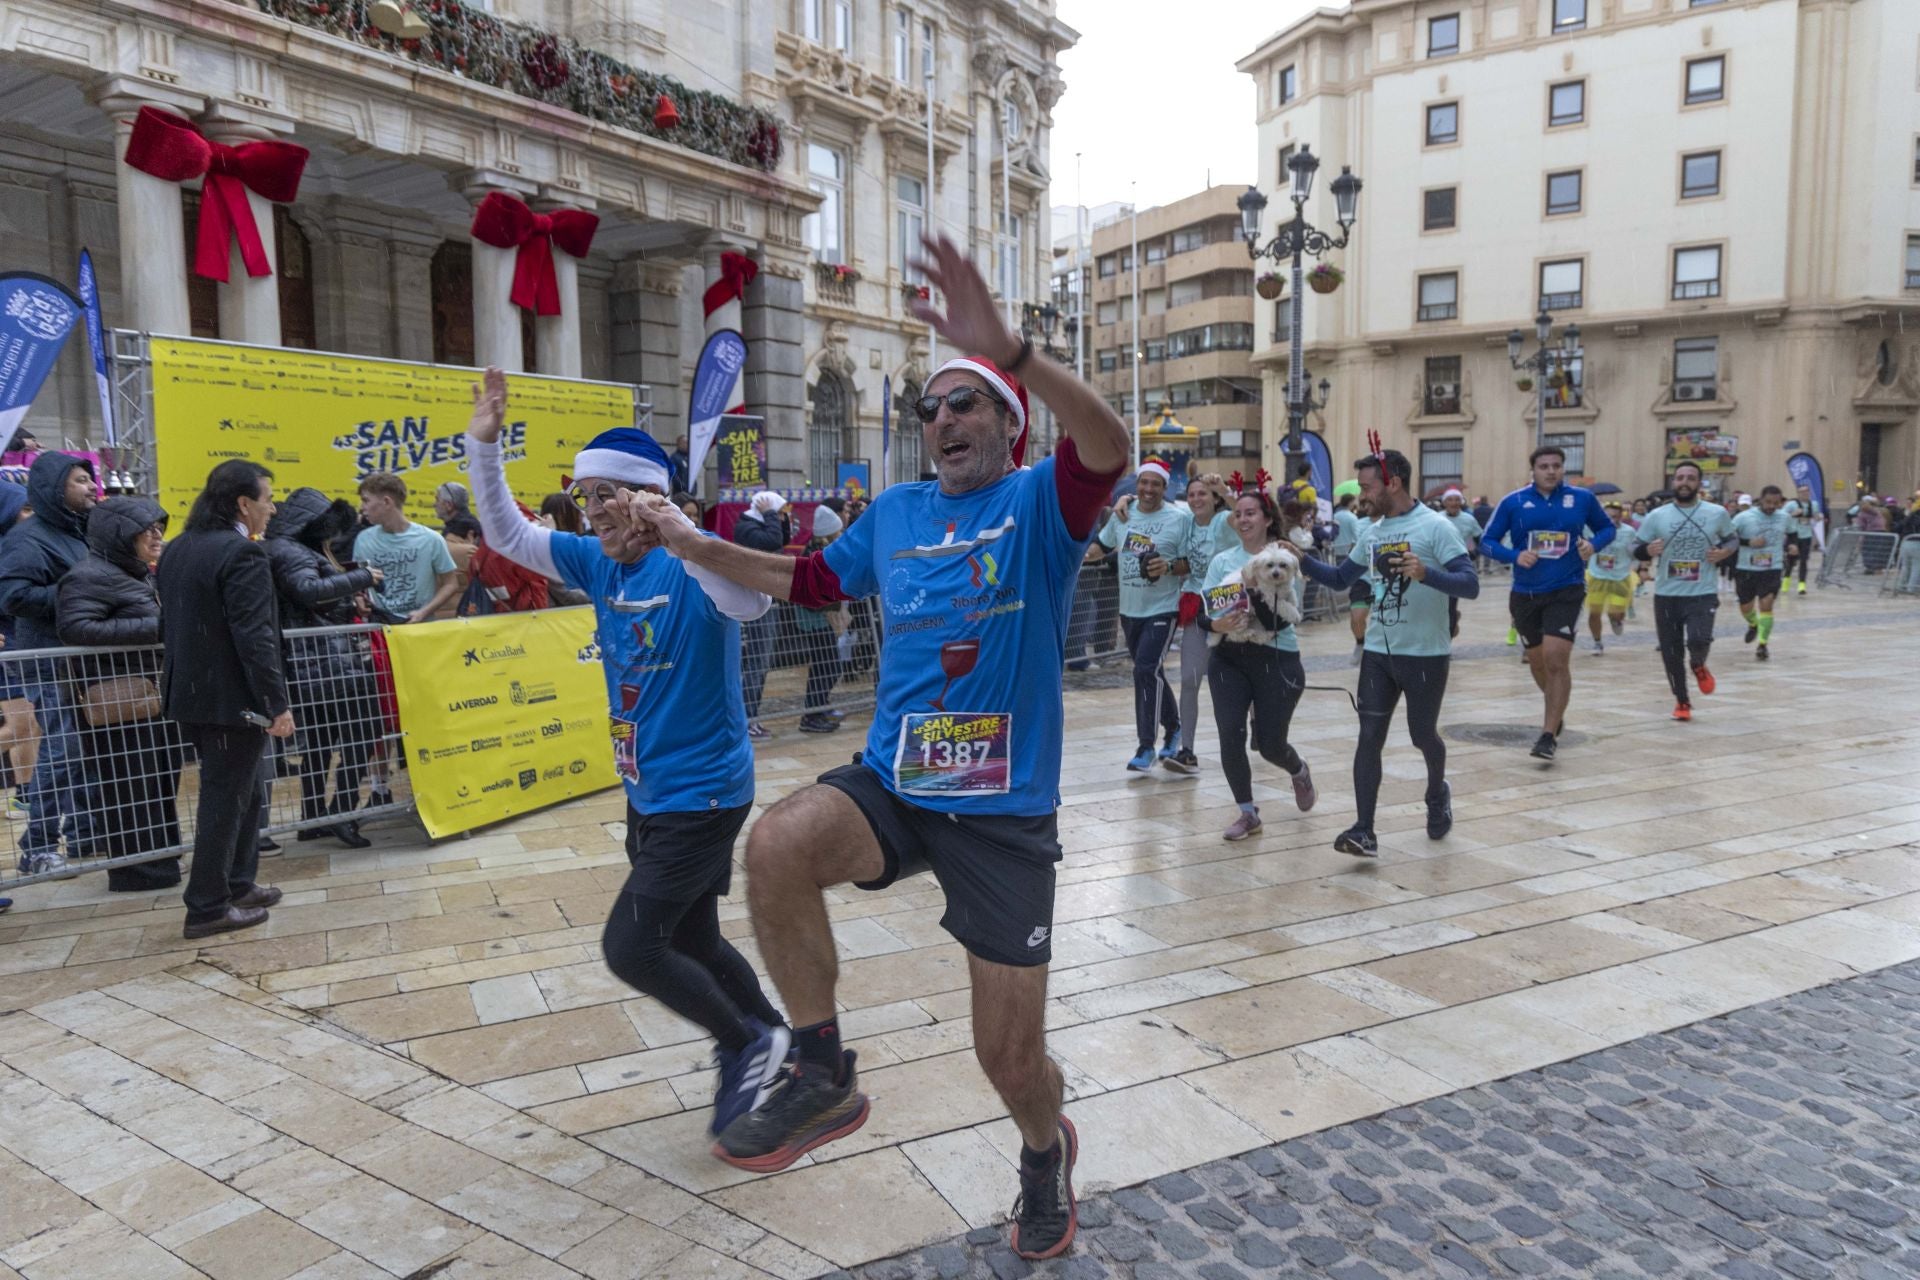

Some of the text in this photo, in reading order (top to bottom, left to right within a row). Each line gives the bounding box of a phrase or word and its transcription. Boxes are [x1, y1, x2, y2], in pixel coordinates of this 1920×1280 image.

[357, 416, 428, 449] SAN
[728, 429, 758, 445] SAN
[733, 442, 752, 458] SIL
[731, 454, 758, 470] VES
[732, 467, 760, 482] TRE
[480, 644, 527, 660] CaixaBank
[449, 696, 498, 712] LA VERDAD
[541, 722, 563, 737] DSM
[923, 717, 1000, 742] SILVESTRE
[924, 716, 954, 732] SAN
[920, 741, 991, 768] 1387
